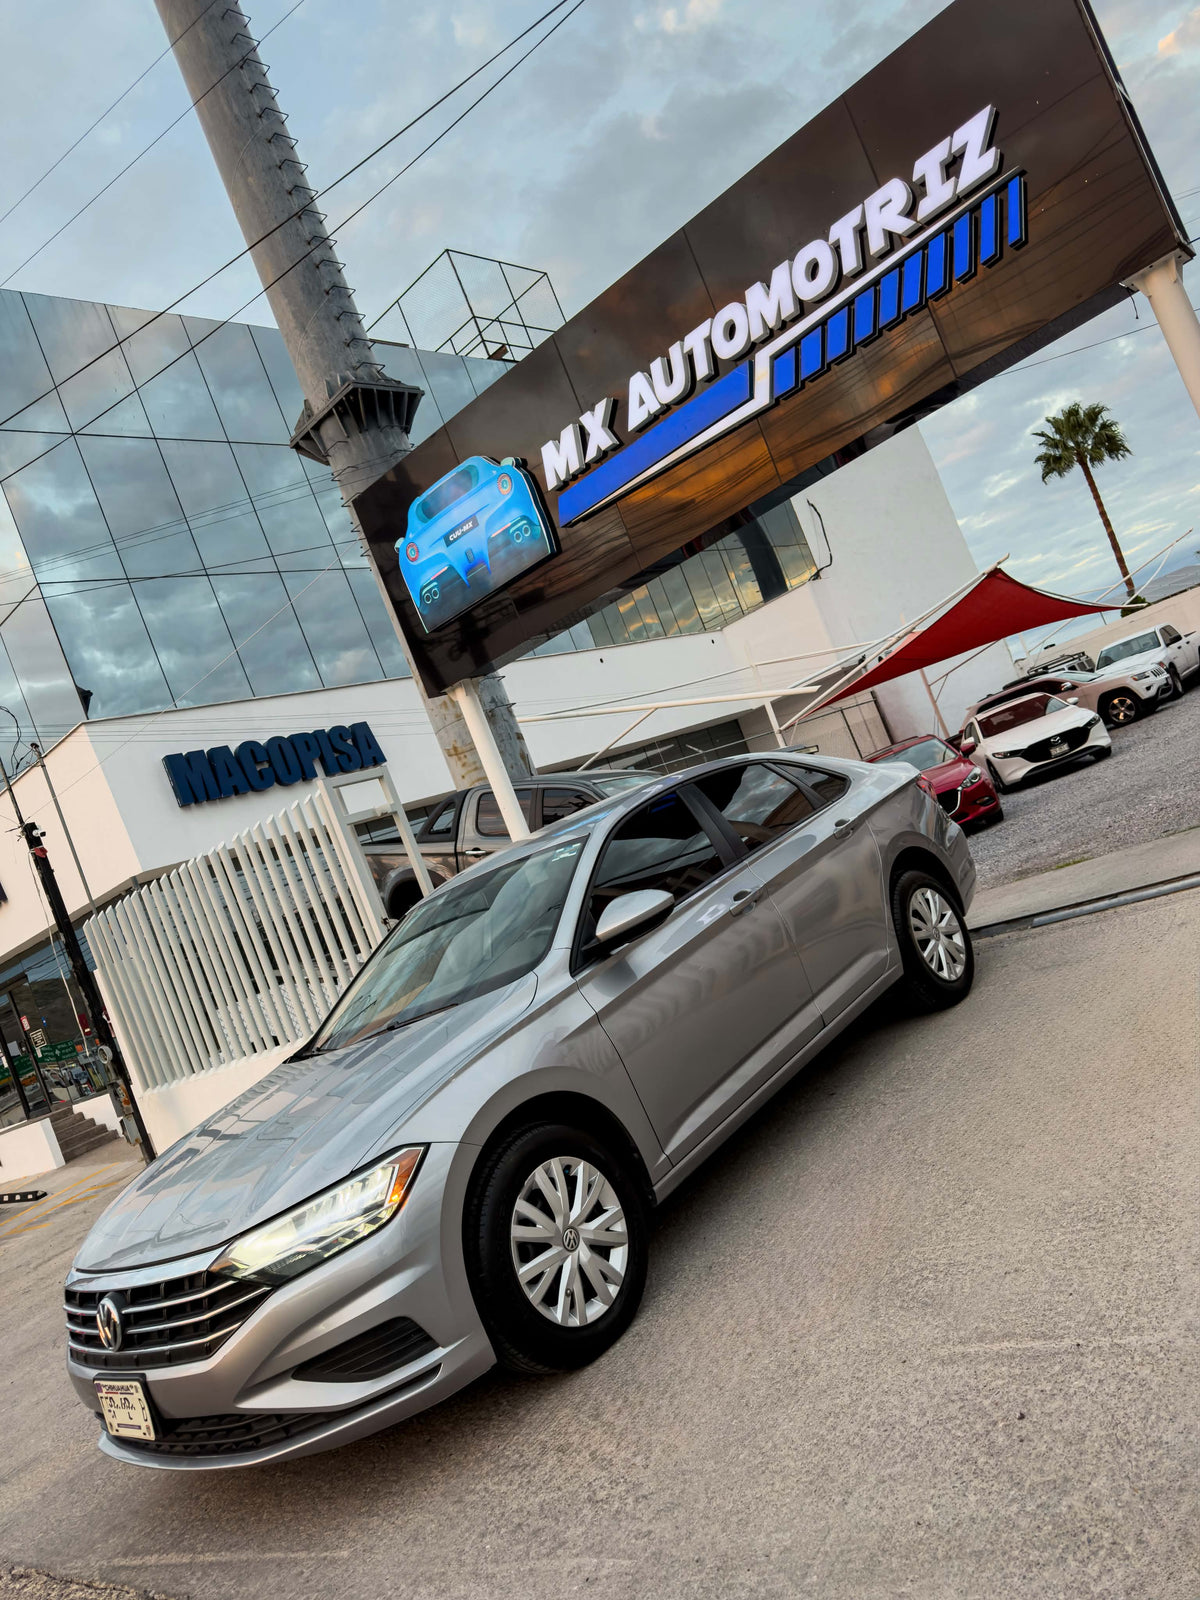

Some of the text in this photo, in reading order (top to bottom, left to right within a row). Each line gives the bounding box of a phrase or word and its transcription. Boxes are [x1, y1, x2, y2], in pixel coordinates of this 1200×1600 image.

[541, 104, 1000, 491] MX AUTOMOTRIZ
[449, 520, 473, 541] CUU-MX
[162, 721, 387, 807] MACOPISA
